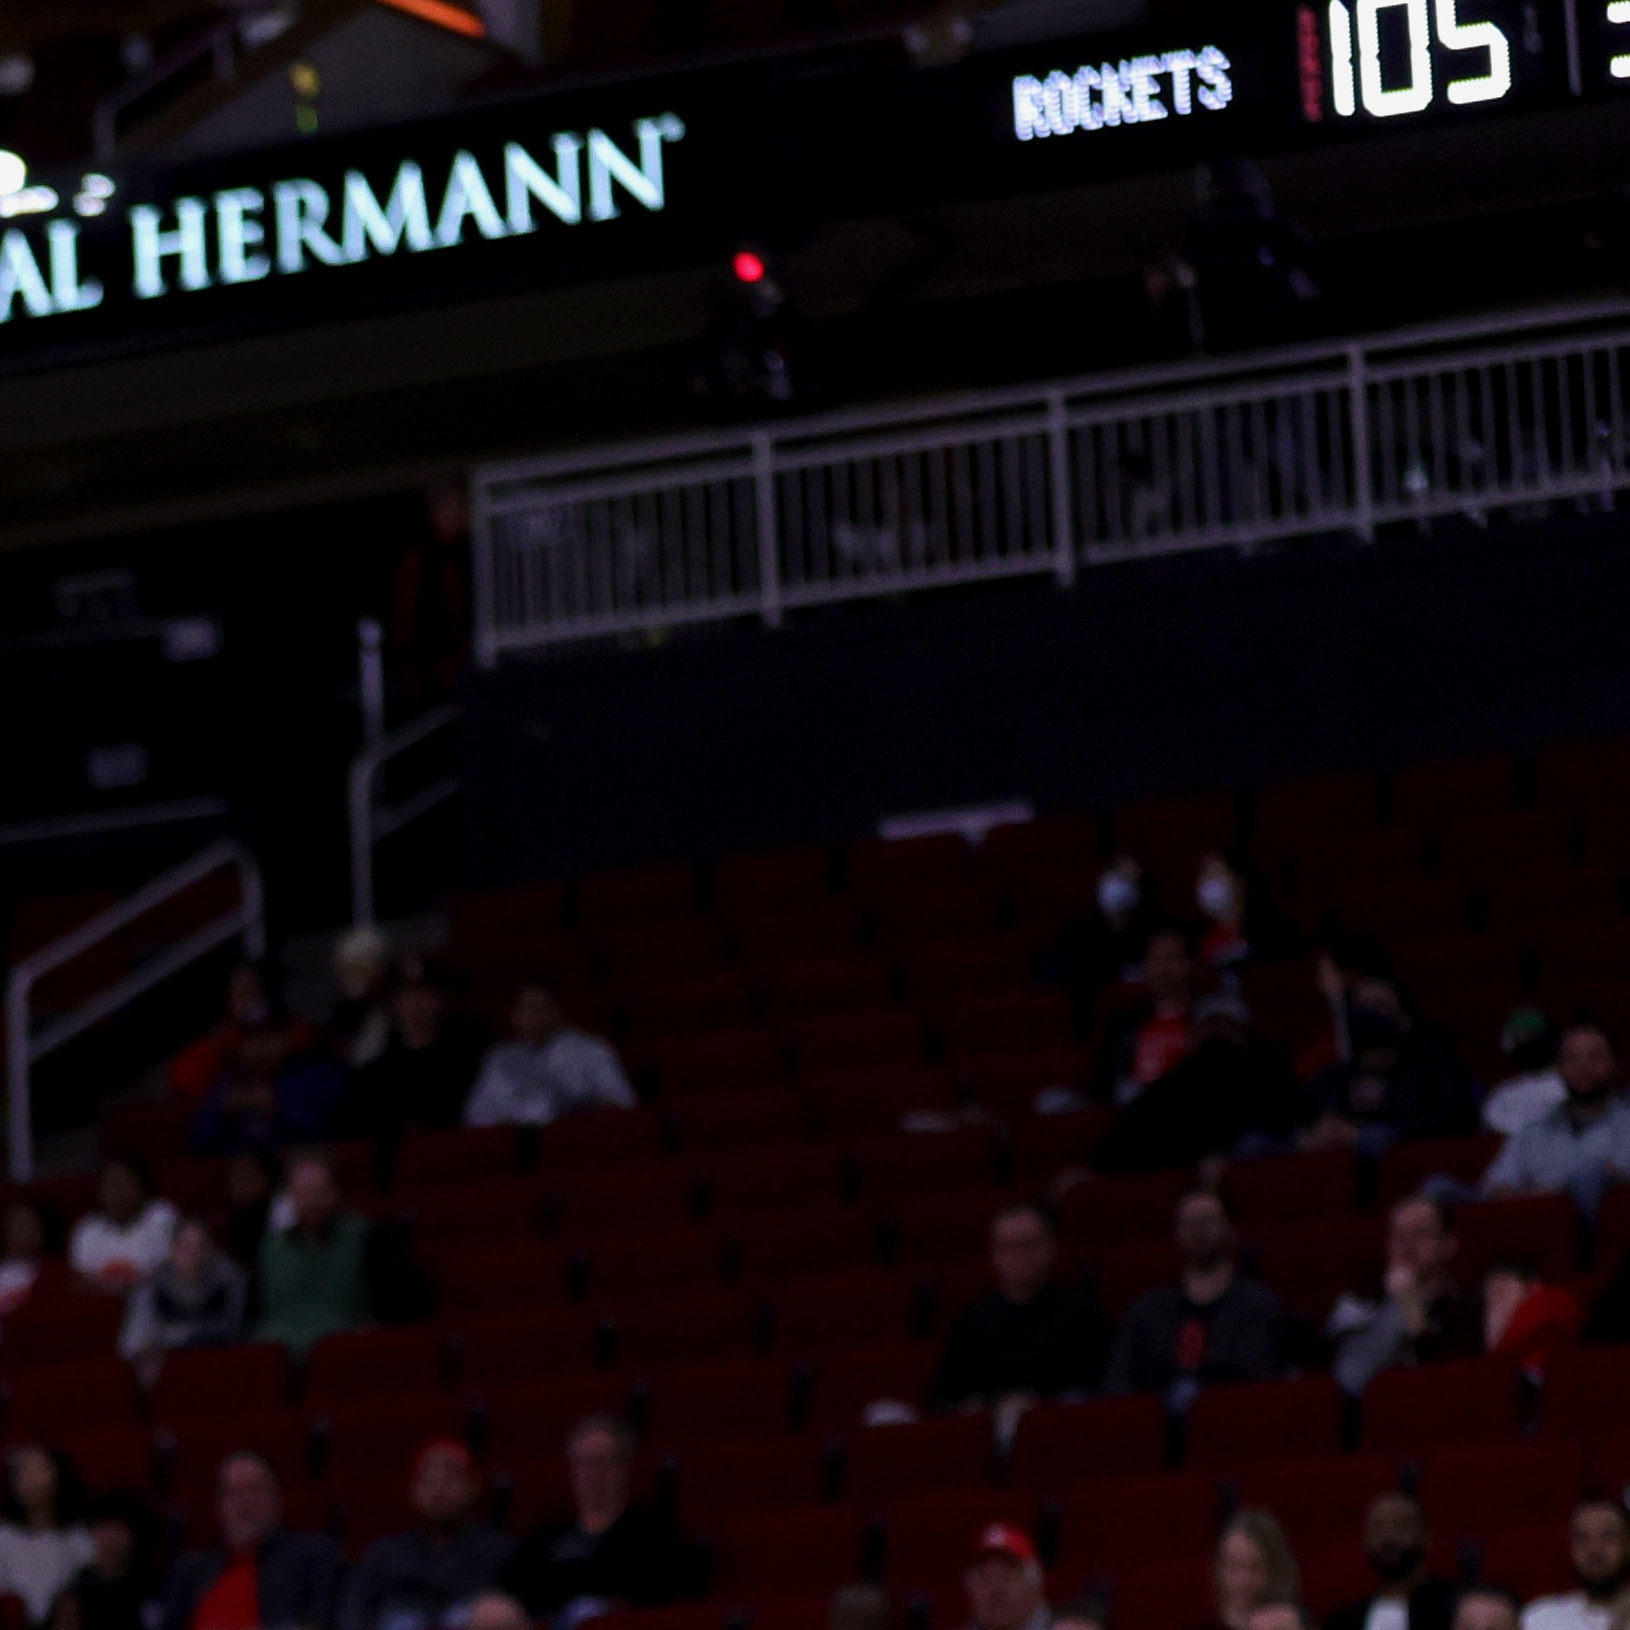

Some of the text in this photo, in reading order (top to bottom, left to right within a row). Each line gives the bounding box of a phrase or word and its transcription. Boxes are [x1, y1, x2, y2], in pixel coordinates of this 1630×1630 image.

[1012, 45, 1232, 141] ROCKETS
[1329, 0, 1511, 117] 105
[131, 115, 672, 298] HERMANN
